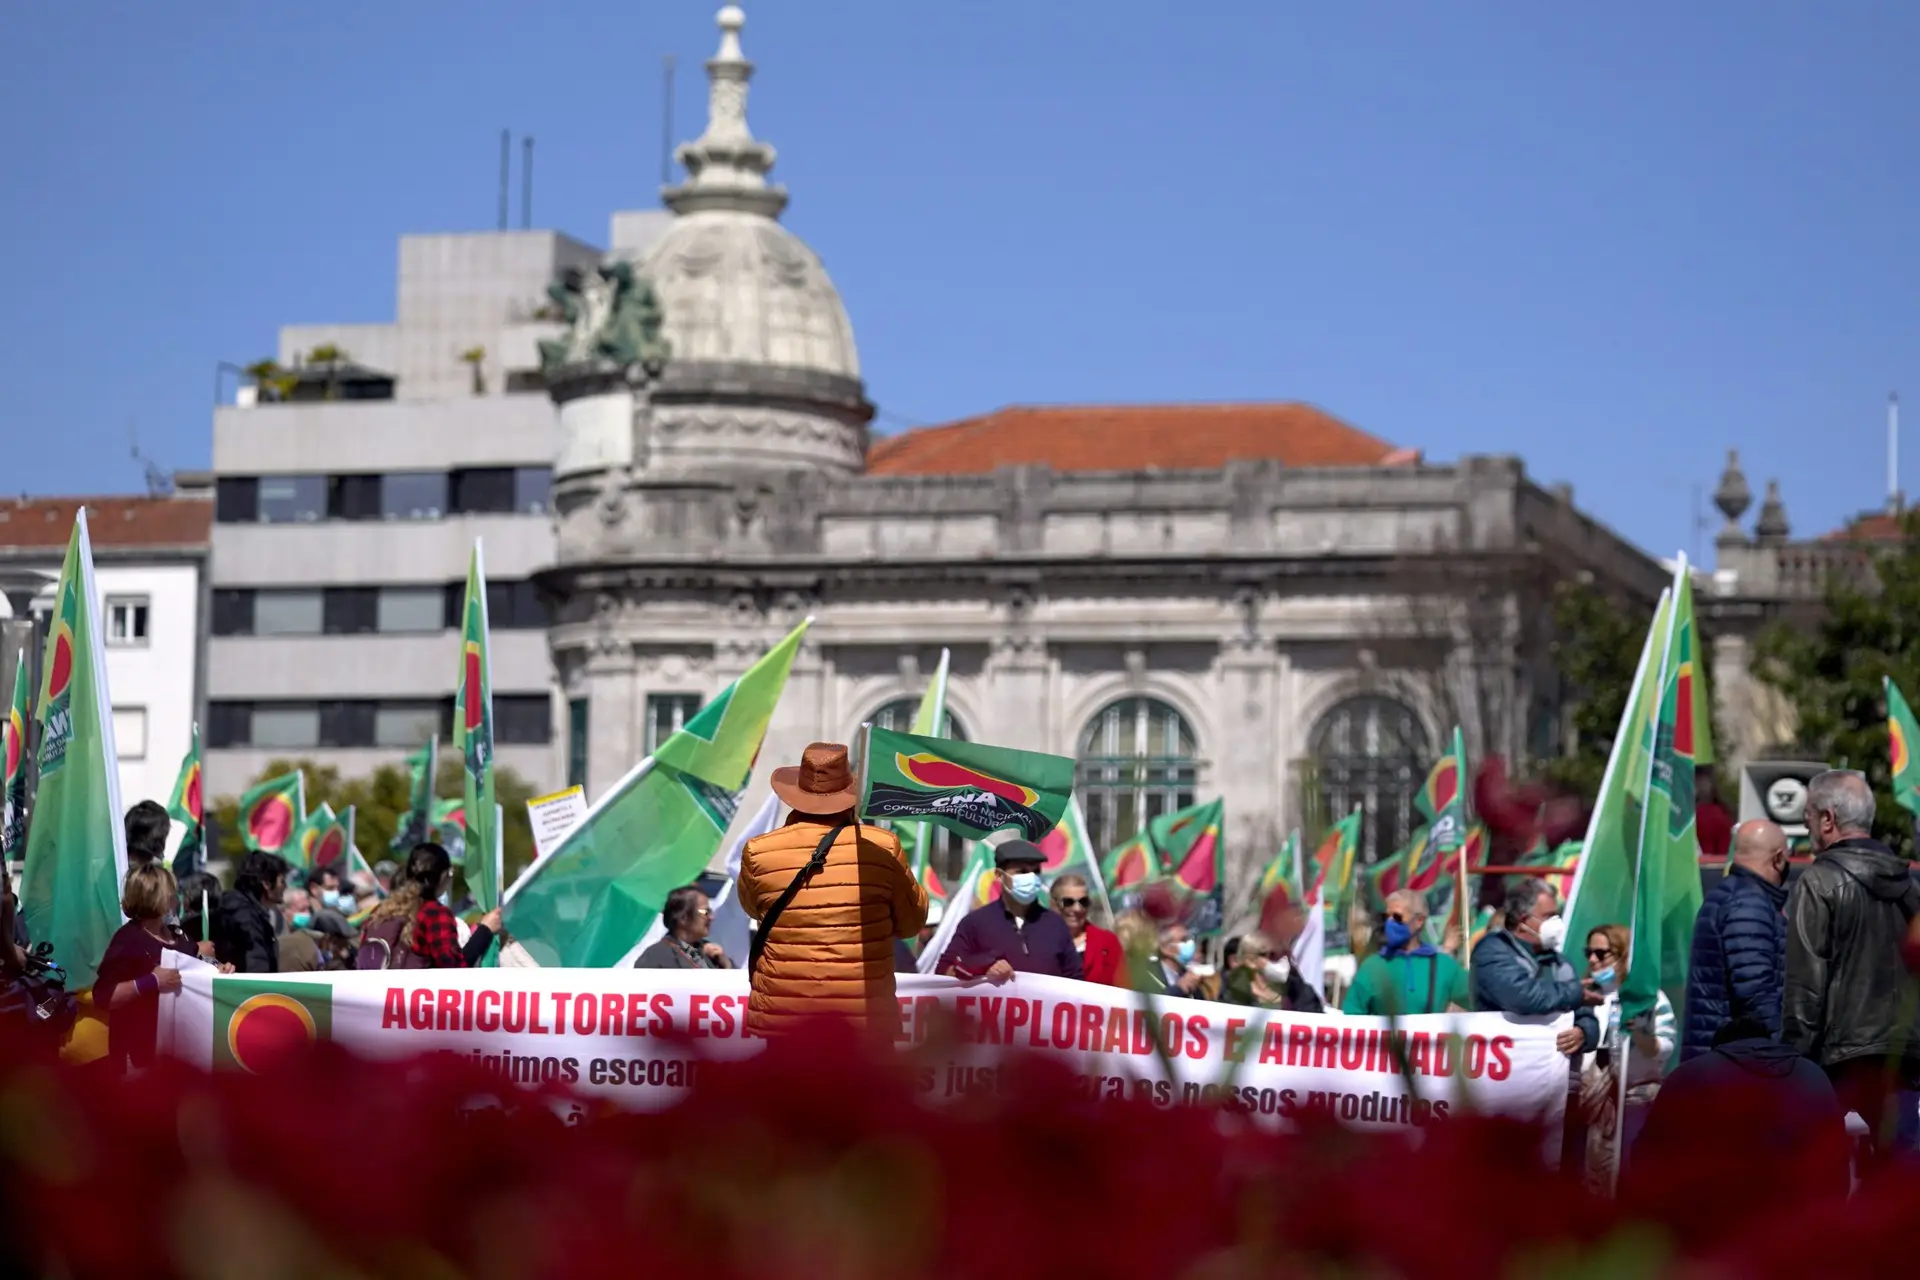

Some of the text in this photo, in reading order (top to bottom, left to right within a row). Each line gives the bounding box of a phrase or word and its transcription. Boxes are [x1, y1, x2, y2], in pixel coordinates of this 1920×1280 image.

[932, 792, 997, 808] CNA
[981, 808, 1034, 828] NACIONAL
[382, 987, 674, 1037] AGRICULTORES
[688, 994, 751, 1038] EST
[956, 996, 1211, 1060] EXPLORADOS
[1223, 1018, 1246, 1063] E
[1259, 1022, 1514, 1081] ARRUINADOS
